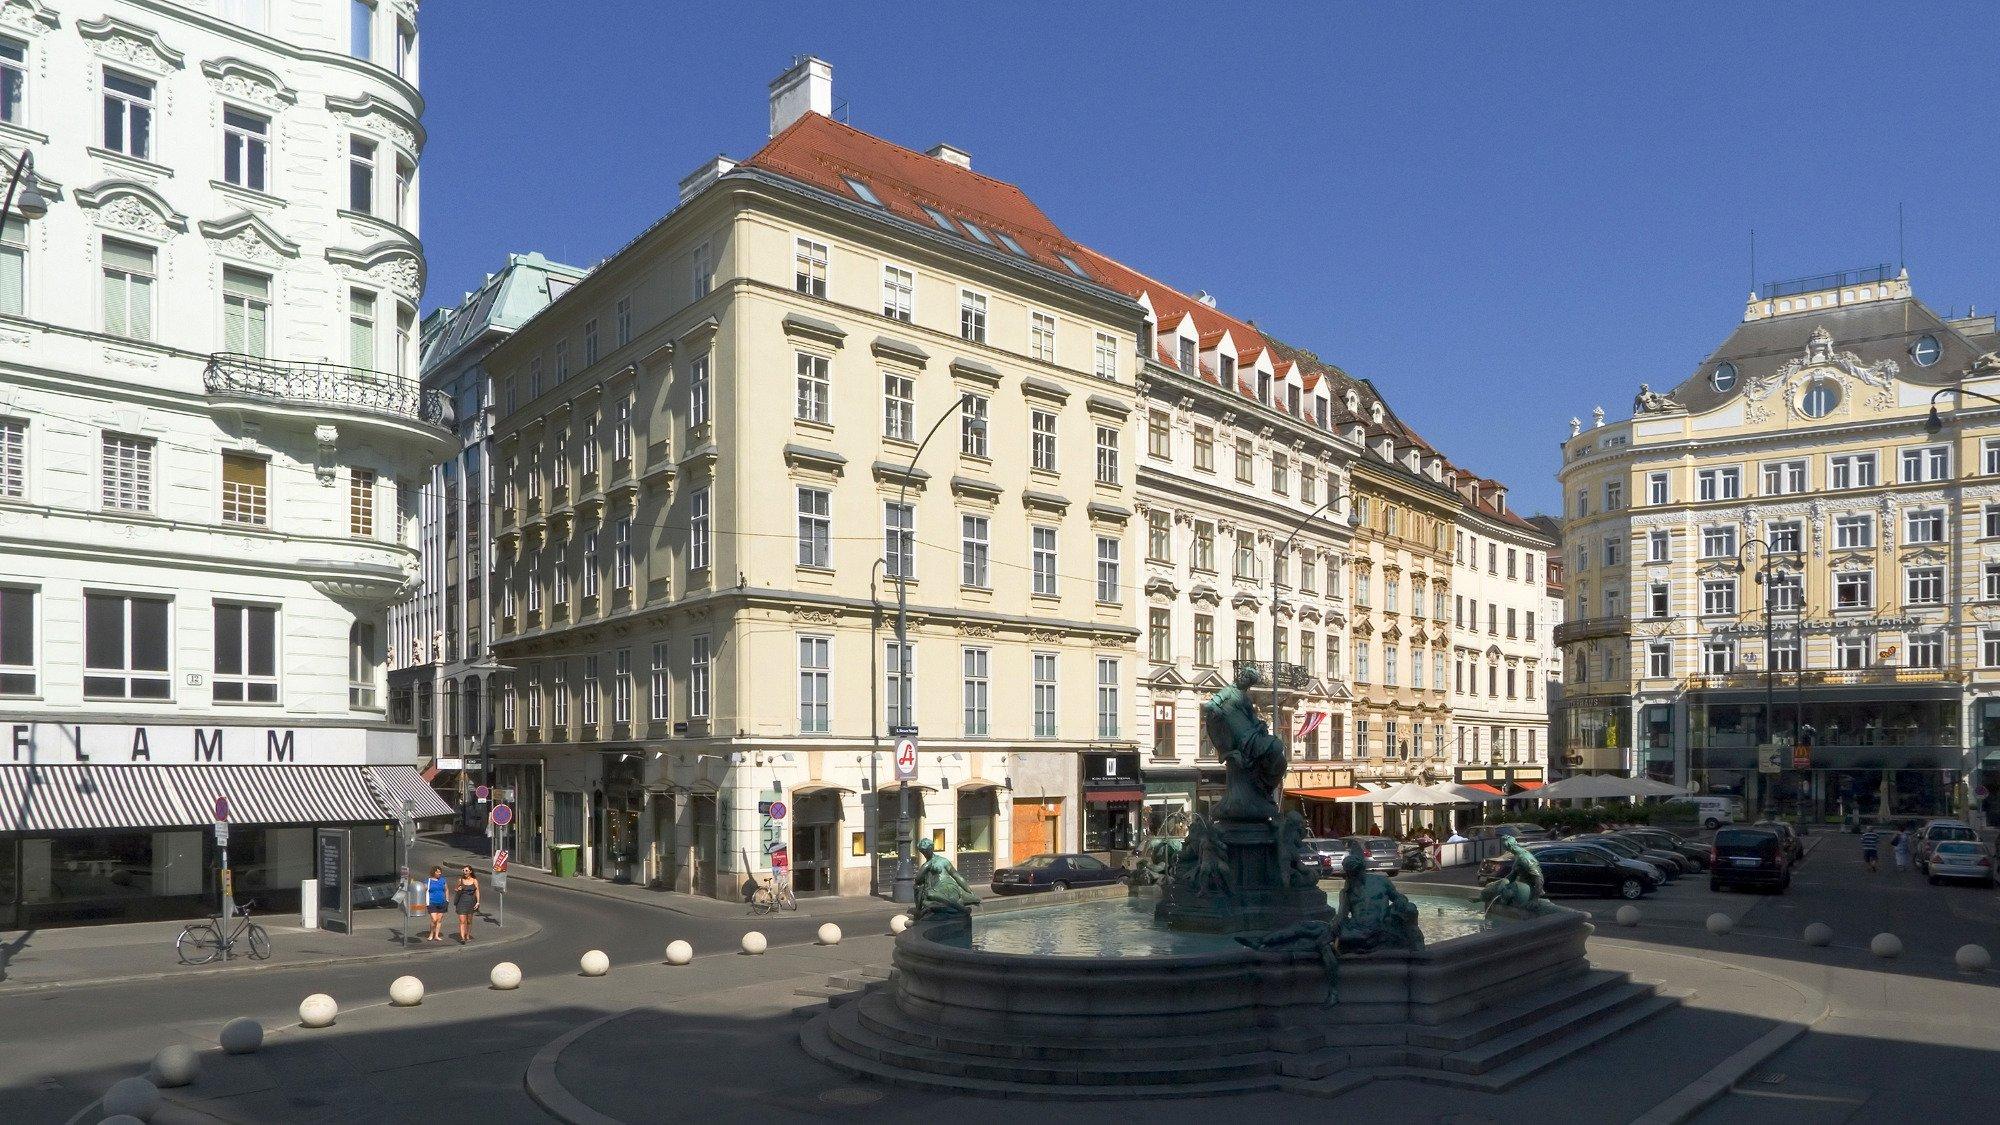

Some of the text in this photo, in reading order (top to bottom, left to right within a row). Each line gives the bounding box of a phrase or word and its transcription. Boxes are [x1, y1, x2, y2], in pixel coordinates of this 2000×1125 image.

[1717, 620, 1791, 633] PENSION
[1799, 616, 1859, 629] NEUER
[12, 725, 294, 762] FLAMM
